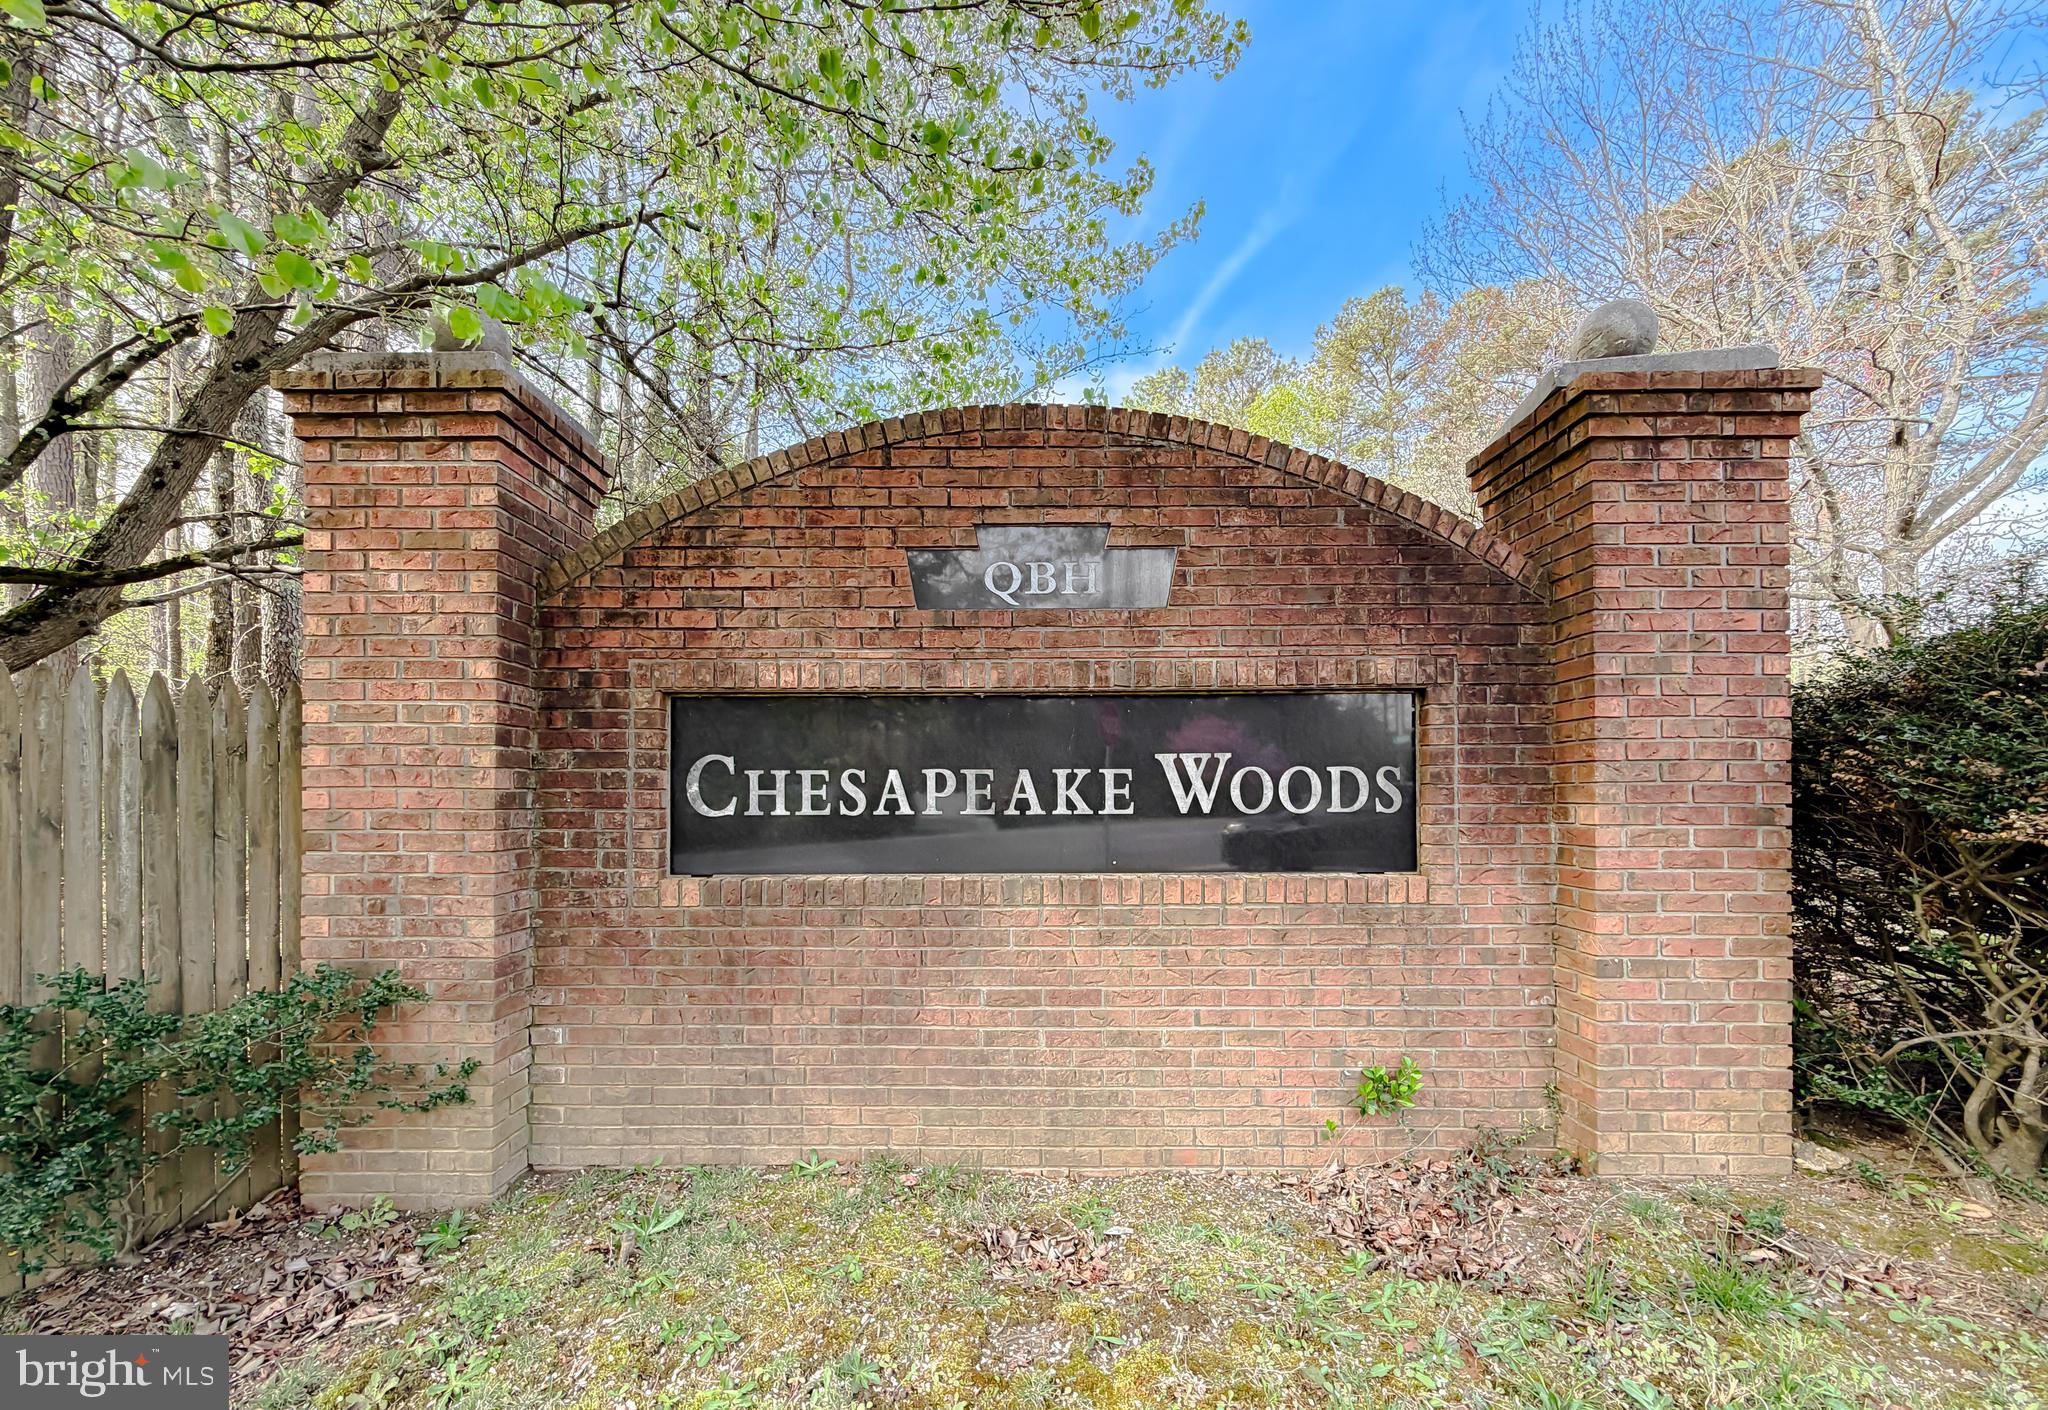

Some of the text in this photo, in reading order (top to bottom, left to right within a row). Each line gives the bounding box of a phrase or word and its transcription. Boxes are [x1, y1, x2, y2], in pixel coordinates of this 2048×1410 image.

[984, 561, 1101, 605] QBH
[685, 752, 1404, 817] CHESAPEAKE WOODS
